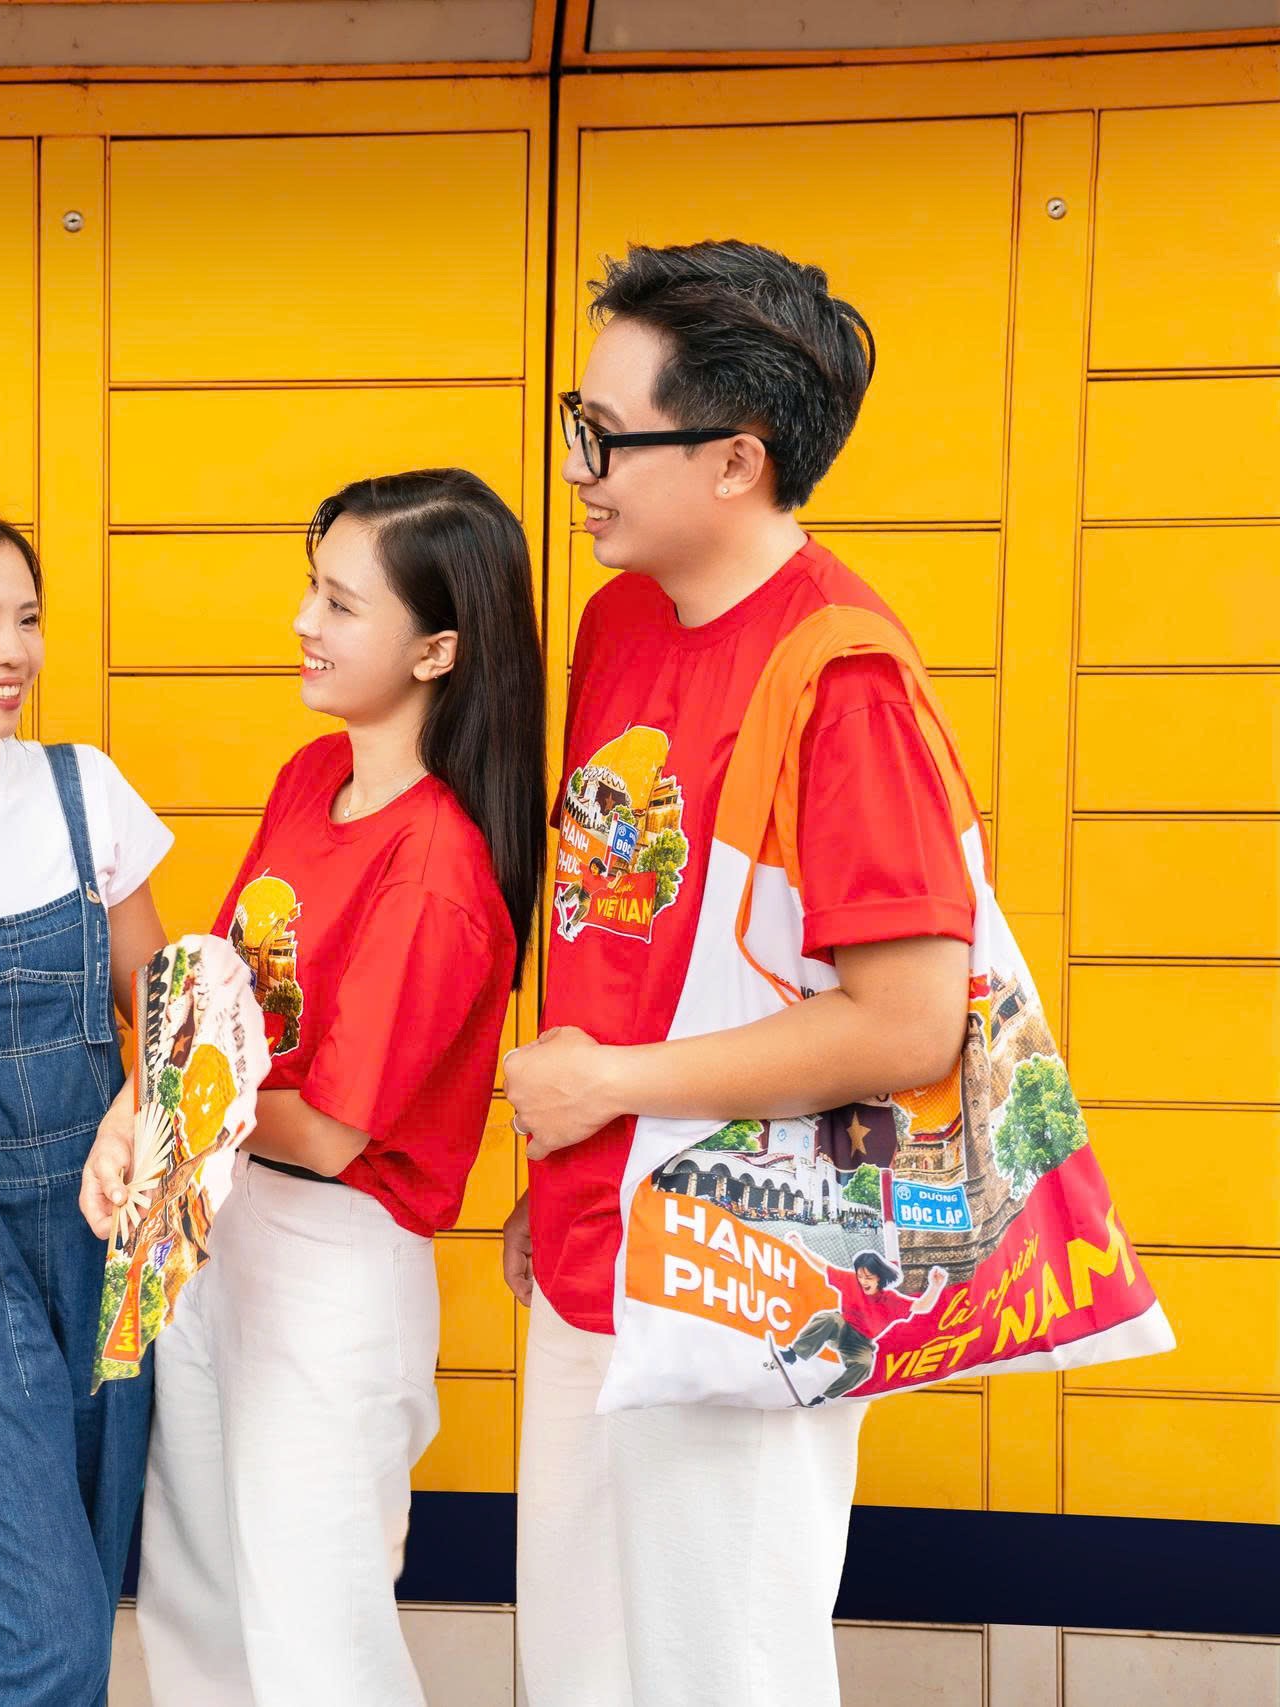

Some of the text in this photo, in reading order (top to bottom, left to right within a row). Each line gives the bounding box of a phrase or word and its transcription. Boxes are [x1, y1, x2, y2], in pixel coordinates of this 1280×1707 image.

[900, 1203, 963, 1227] ĐỘC LẬP
[886, 1206, 1136, 1382] VIỆT NAM
[938, 1287, 978, 1331] là
